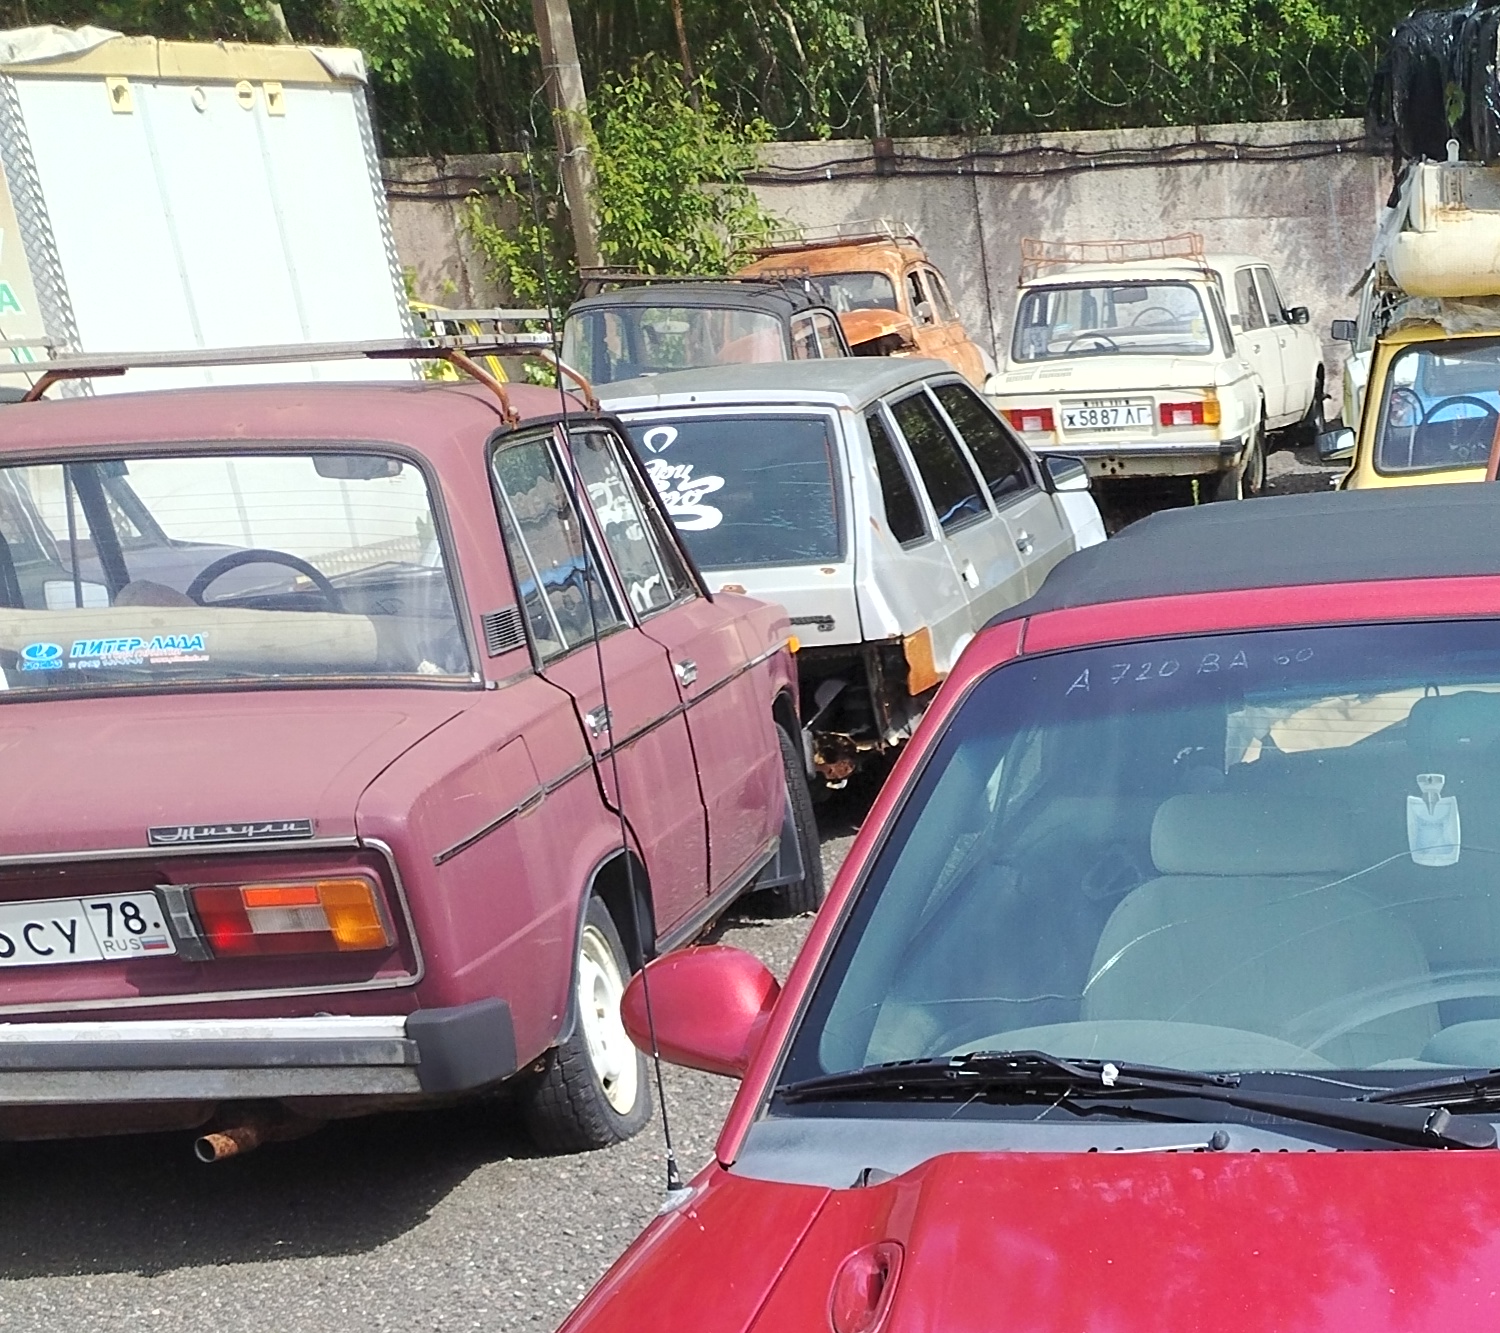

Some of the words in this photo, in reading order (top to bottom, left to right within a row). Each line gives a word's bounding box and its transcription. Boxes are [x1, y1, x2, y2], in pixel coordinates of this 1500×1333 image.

[1110, 661, 1180, 685] 720
[90, 901, 147, 938] 78
[103, 937, 141, 953] RUS
